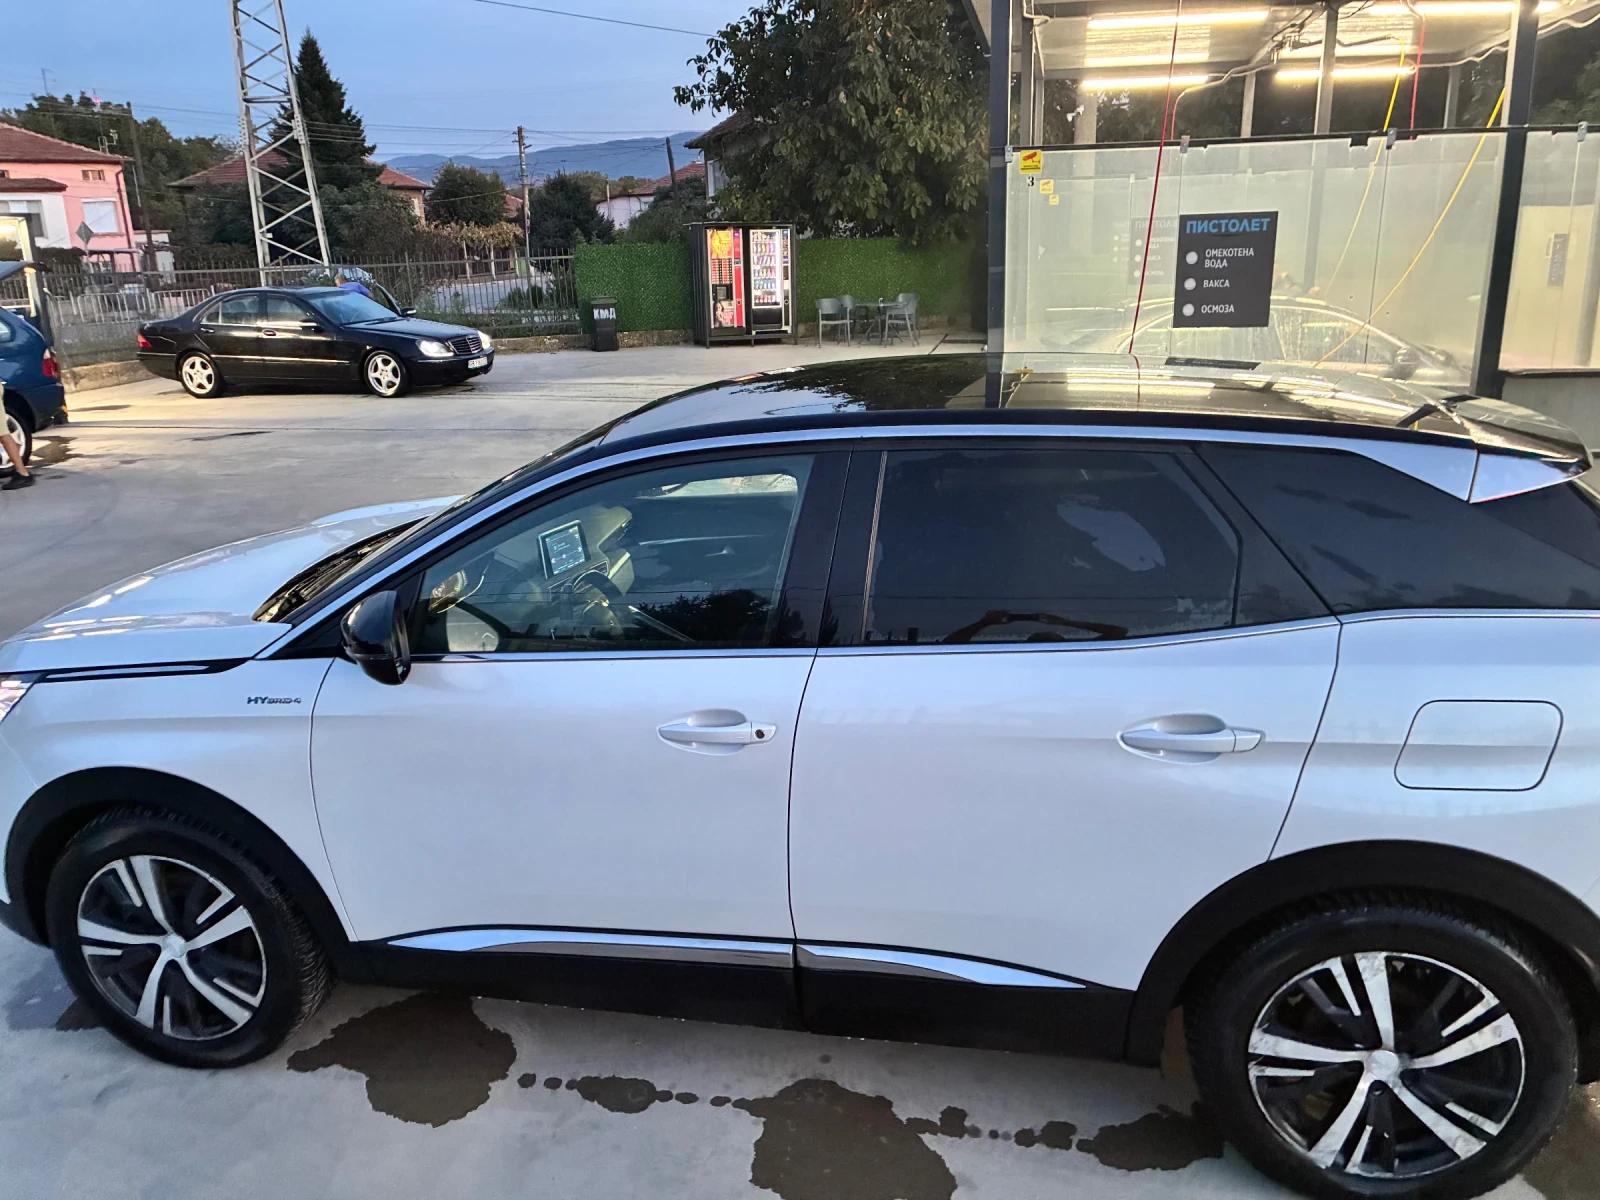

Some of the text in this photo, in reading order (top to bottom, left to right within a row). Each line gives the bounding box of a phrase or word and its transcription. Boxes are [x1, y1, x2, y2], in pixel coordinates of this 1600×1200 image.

[1027, 176, 1035, 187] 3
[1186, 218, 1271, 234] ПИСТОЛЕТ
[1205, 247, 1255, 258] ОМЕКОТЕНА
[1204, 258, 1228, 269] ВОДА
[1203, 279, 1230, 288] ВАКСА
[1201, 304, 1235, 314] ОСМОЗА
